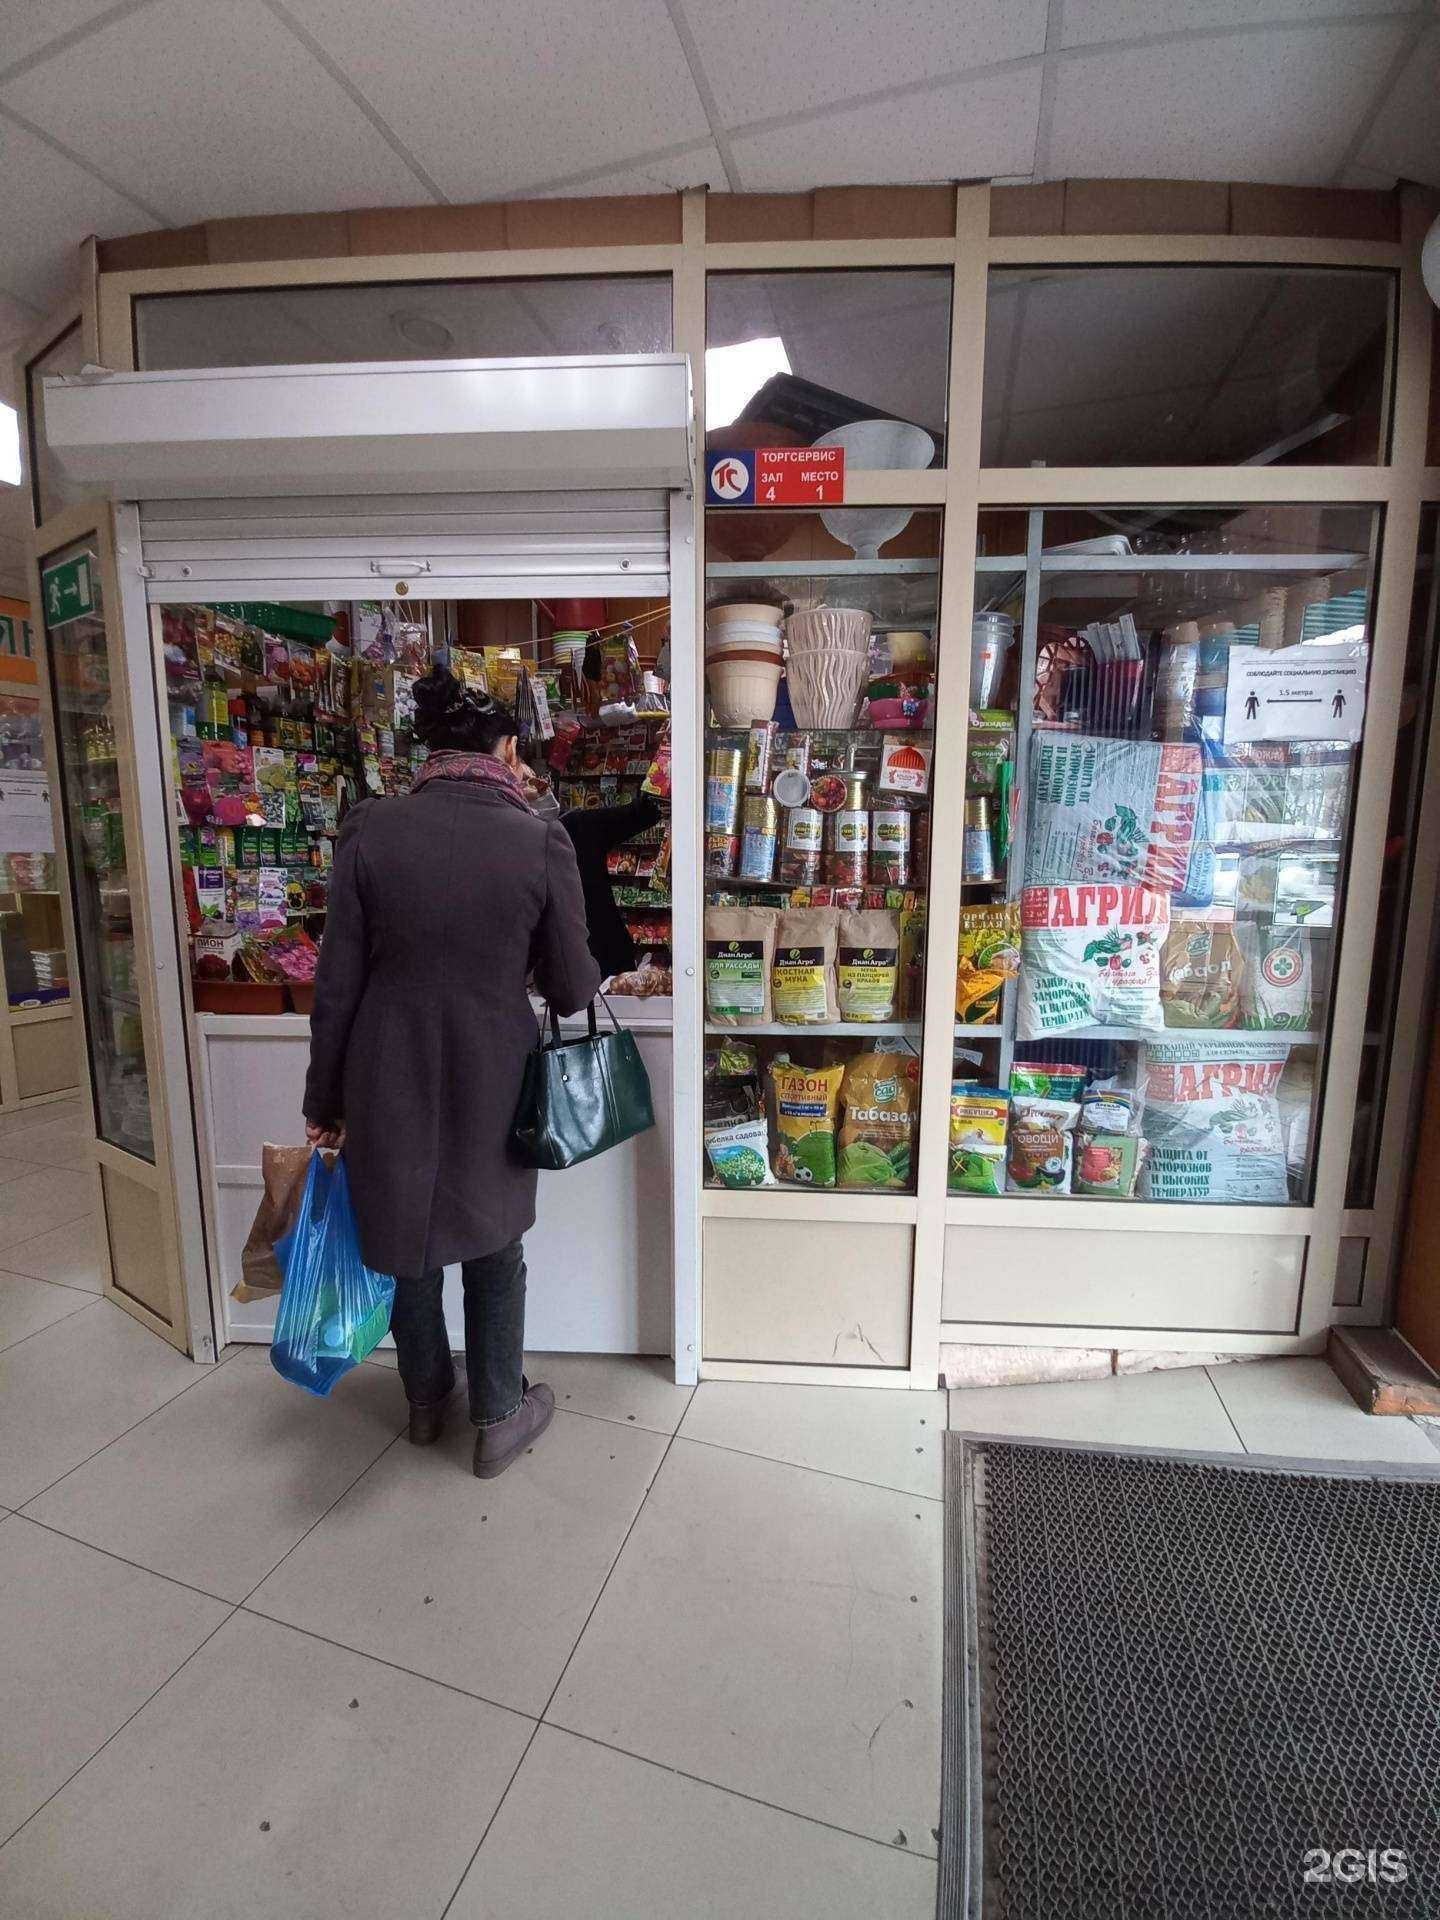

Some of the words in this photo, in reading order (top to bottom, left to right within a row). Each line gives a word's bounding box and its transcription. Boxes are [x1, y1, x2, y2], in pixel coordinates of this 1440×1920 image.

[762, 451, 836, 463] ТОРГСЕРВИС
[761, 472, 783, 483] ЗАЛ
[801, 471, 839, 482] МЕСТО
[765, 486, 776, 501] 4
[816, 485, 824, 500] 1
[1051, 885, 1168, 927] АГРИЛ
[196, 939, 225, 948] ПИОН
[782, 1077, 828, 1092] ГАЗОН
[1017, 1134, 1059, 1145] ОВОЩИ
[1150, 1150, 1194, 1161] ЗАЩИТА
[1195, 1150, 1208, 1160] ОТ
[1146, 1161, 1212, 1173] ЗАМОРОЗКОВ
[1151, 1174, 1159, 1184] И
[1162, 1174, 1210, 1186] ВЫСОКИХ
[1151, 1186, 1210, 1198] ТЕМПЕРАТУР
